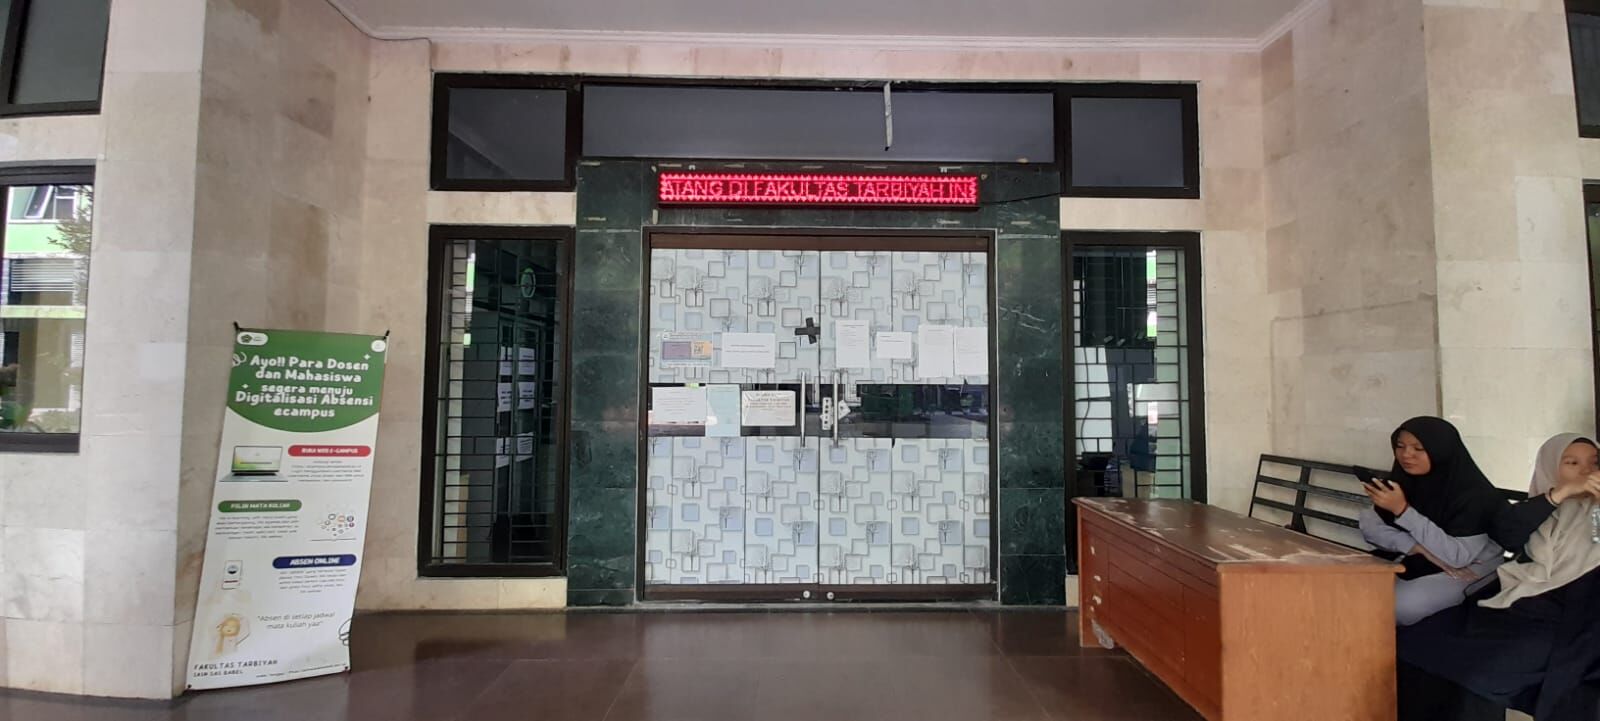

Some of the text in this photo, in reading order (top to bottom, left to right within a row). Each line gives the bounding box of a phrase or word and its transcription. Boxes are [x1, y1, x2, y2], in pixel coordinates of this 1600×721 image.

[664, 180, 723, 196] ATANG
[729, 181, 748, 196] DI
[754, 181, 848, 197] FAKULTAS
[854, 182, 944, 198] TARBIYAH
[250, 355, 369, 371] Ayo!! Para Dosen
[255, 367, 362, 383] dan Mahasiswa
[261, 384, 353, 397] segera menuju
[235, 391, 373, 406] Digitalisasi Absensi
[274, 407, 336, 420] ecampus
[289, 557, 341, 566] ABSEN ONLINE
[194, 659, 278, 671] FAKULTAS TARBIYAH
